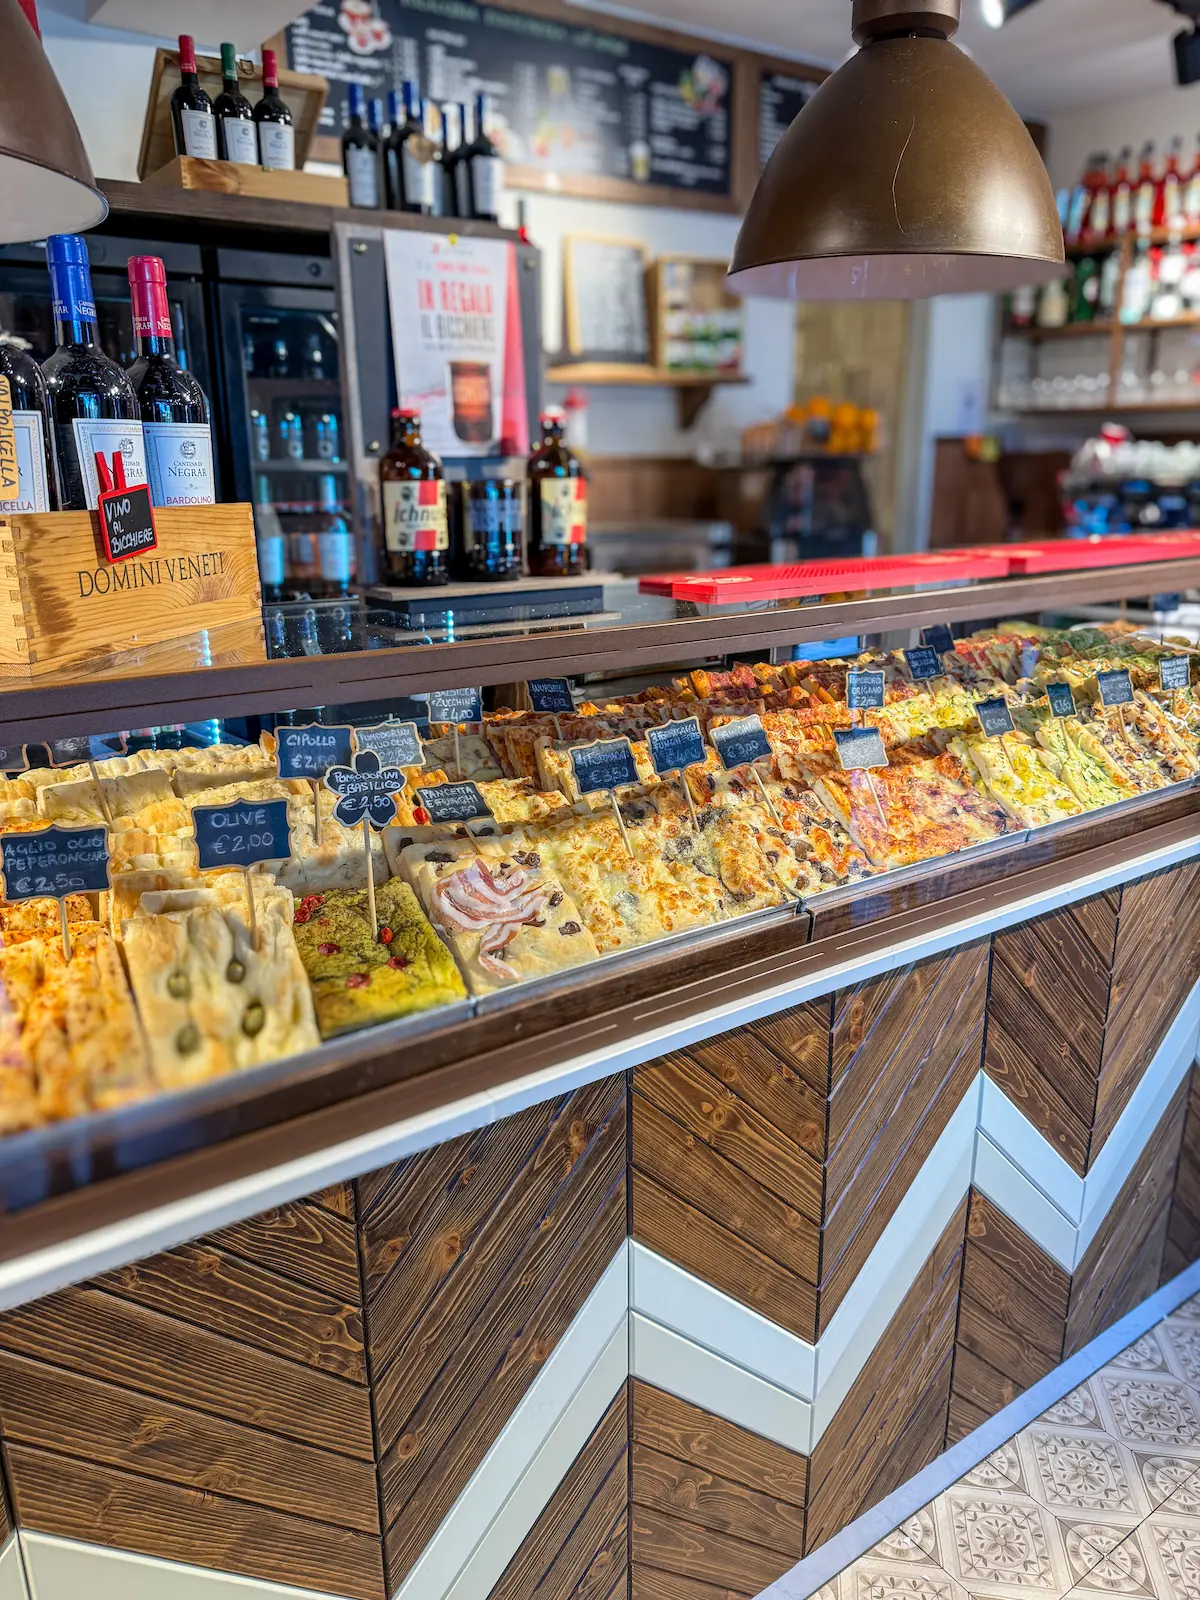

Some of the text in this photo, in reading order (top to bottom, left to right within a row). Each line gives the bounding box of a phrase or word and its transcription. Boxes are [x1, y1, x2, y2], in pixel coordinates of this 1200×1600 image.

[168, 466, 208, 477] NEGRAR
[166, 496, 212, 505] BARDOLINO
[105, 498, 131, 523] VINO
[112, 520, 125, 535] AL
[110, 527, 154, 554] BICCHIERE
[164, 551, 225, 583] VENETI
[851, 685, 883, 695] ORIGANO
[286, 733, 337, 747] CIPOLLA
[333, 770, 399, 784] POMODORINI
[420, 786, 474, 800] PANCETTA
[211, 808, 266, 829] OLIVE
[4, 835, 104, 857] AGLIO OLIO
[5, 850, 108, 872] PEPERONCINO
